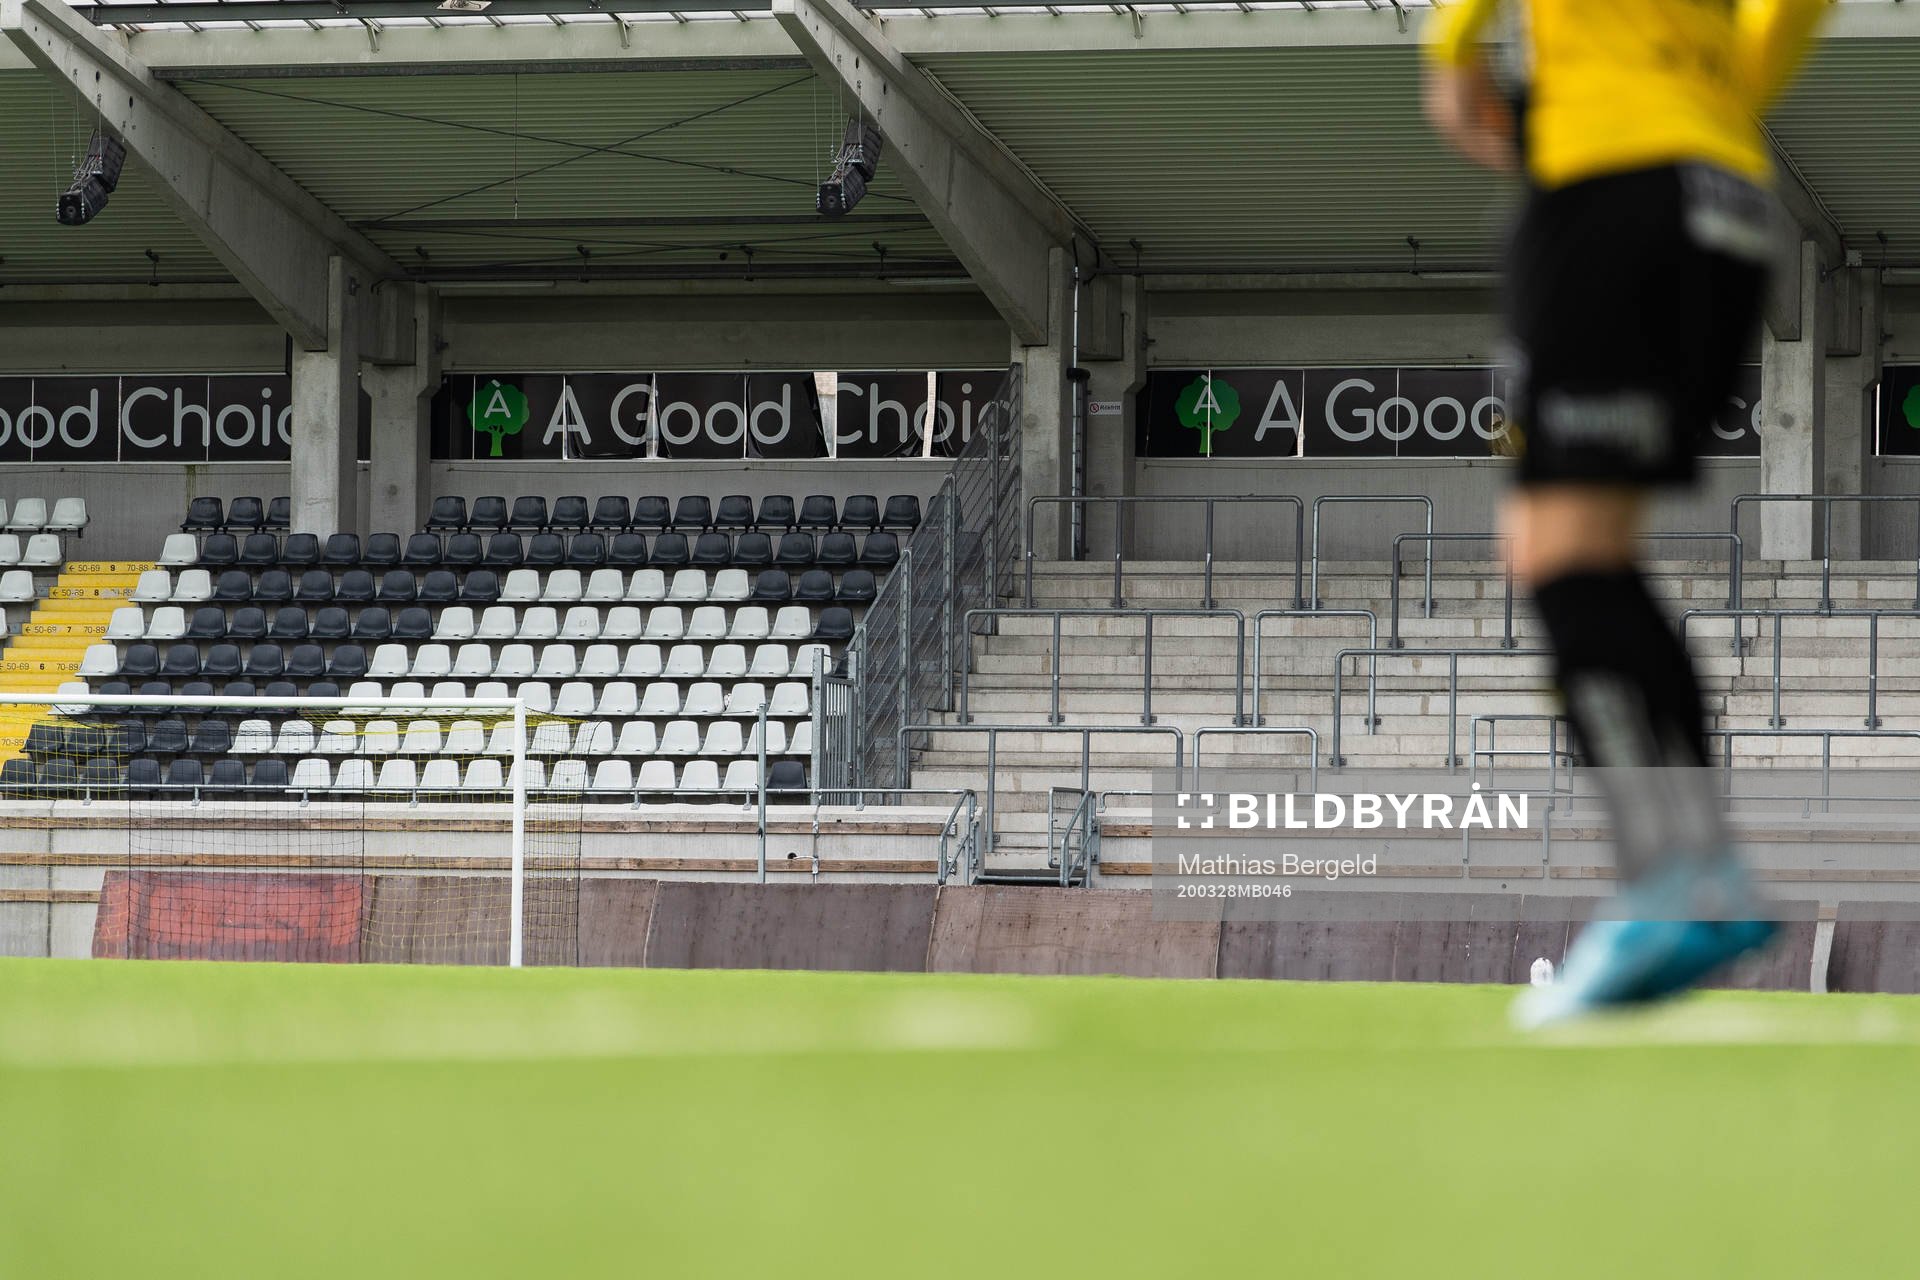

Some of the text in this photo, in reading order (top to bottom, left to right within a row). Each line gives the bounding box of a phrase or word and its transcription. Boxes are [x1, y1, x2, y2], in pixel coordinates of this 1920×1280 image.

[542, 384, 592, 446] A
[610, 383, 792, 446] Good
[1254, 379, 1305, 442] A
[78, 564, 100, 572] 50-69
[110, 564, 116, 572] 9
[94, 588, 99, 597] 8
[34, 625, 106, 634] 50-69 7 70-89
[6, 662, 79, 671] 50-69 6 70-89
